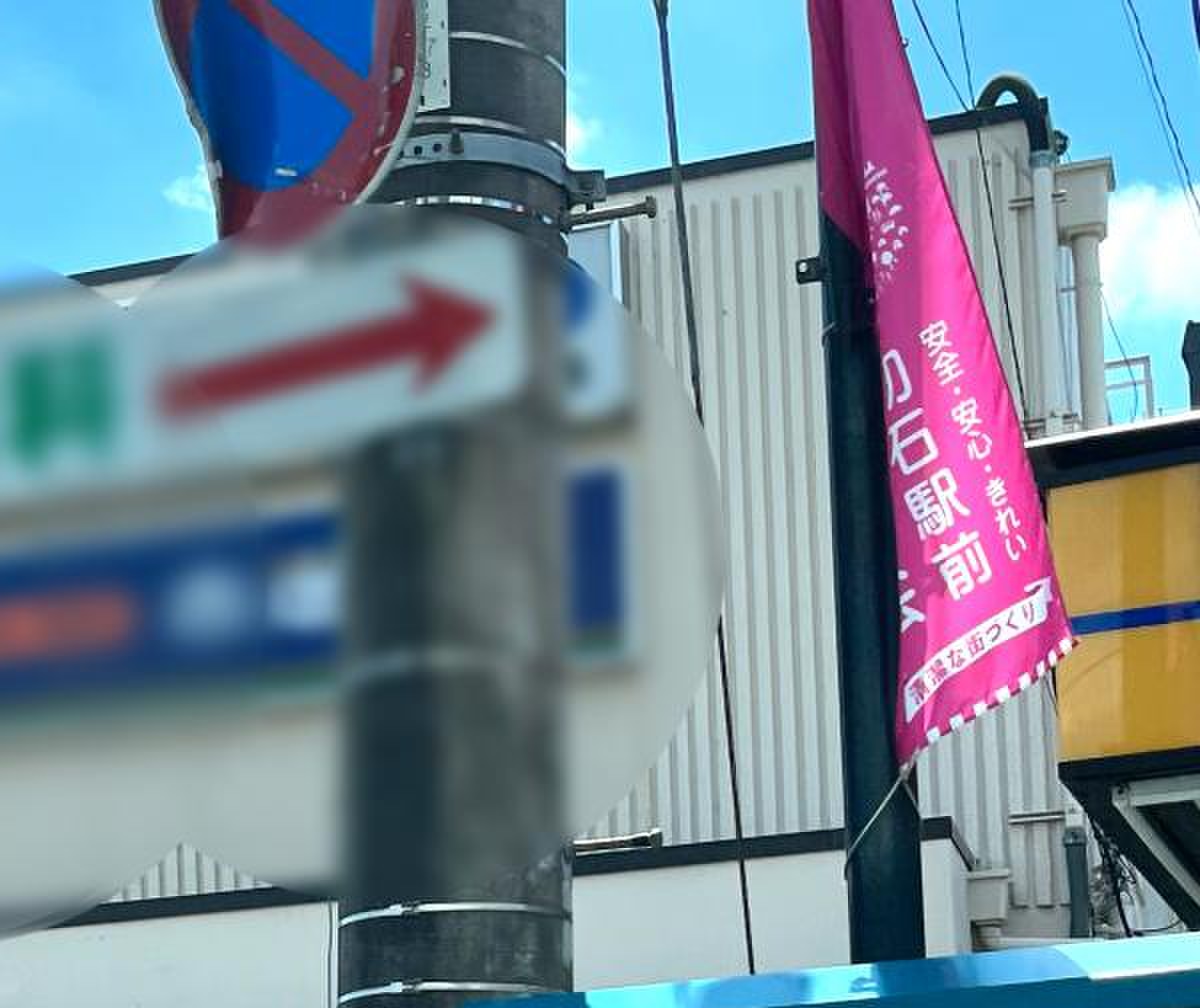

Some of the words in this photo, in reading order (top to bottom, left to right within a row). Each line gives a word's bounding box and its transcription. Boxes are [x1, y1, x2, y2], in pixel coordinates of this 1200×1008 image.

[918, 319, 1028, 562] 安全・安心・きれい
